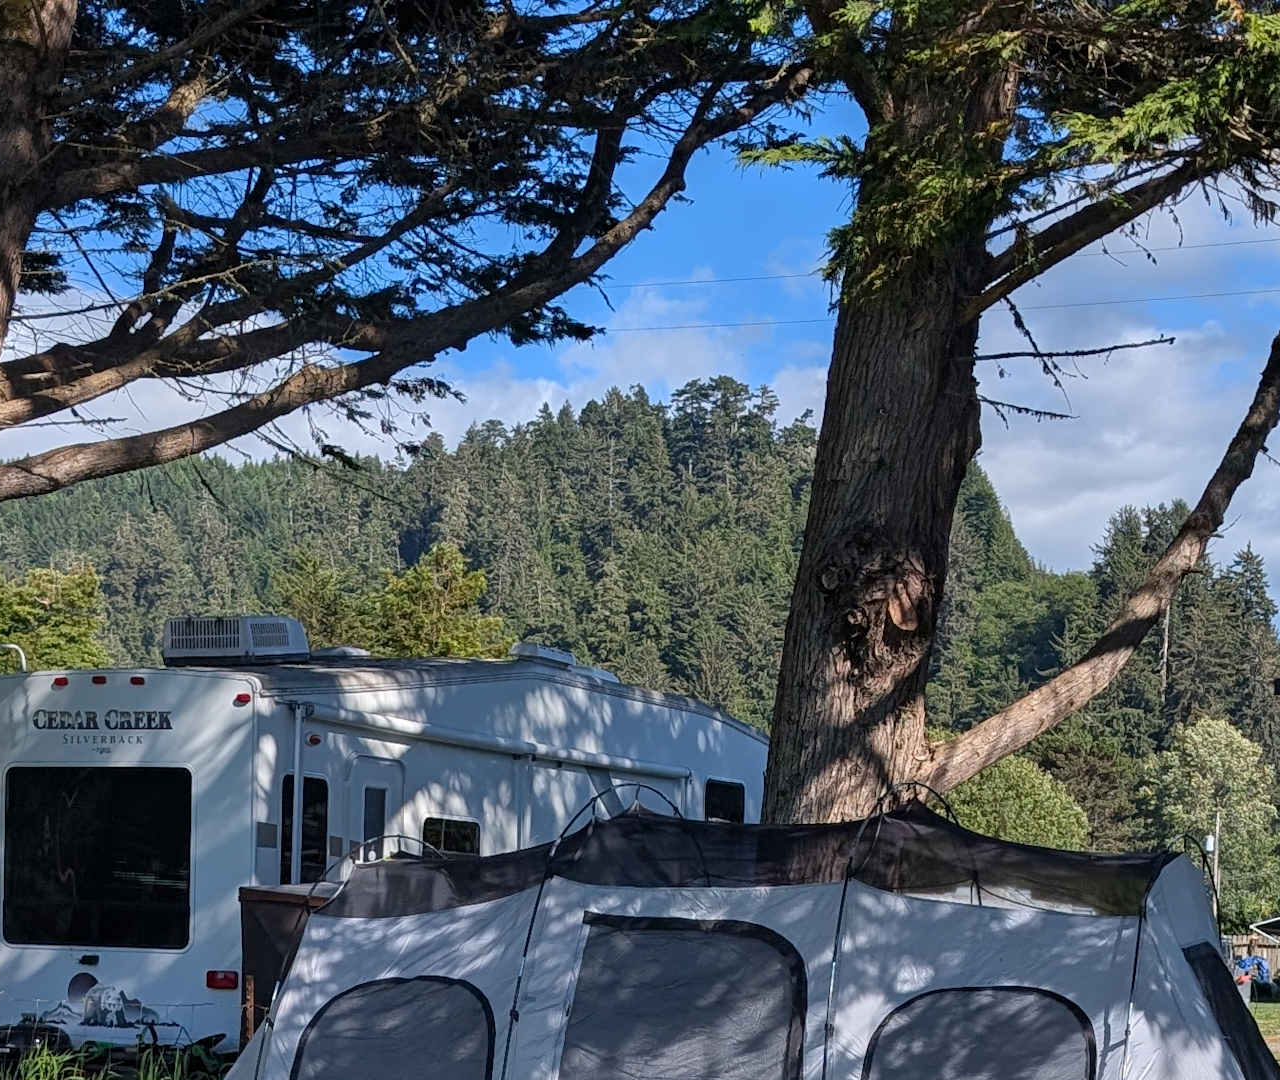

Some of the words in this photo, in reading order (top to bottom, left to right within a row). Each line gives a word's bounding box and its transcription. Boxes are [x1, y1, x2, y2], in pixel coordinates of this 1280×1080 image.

[32, 708, 100, 730] CEDAR
[104, 708, 173, 730] CREEK
[63, 733, 144, 745] SILVERBACK
